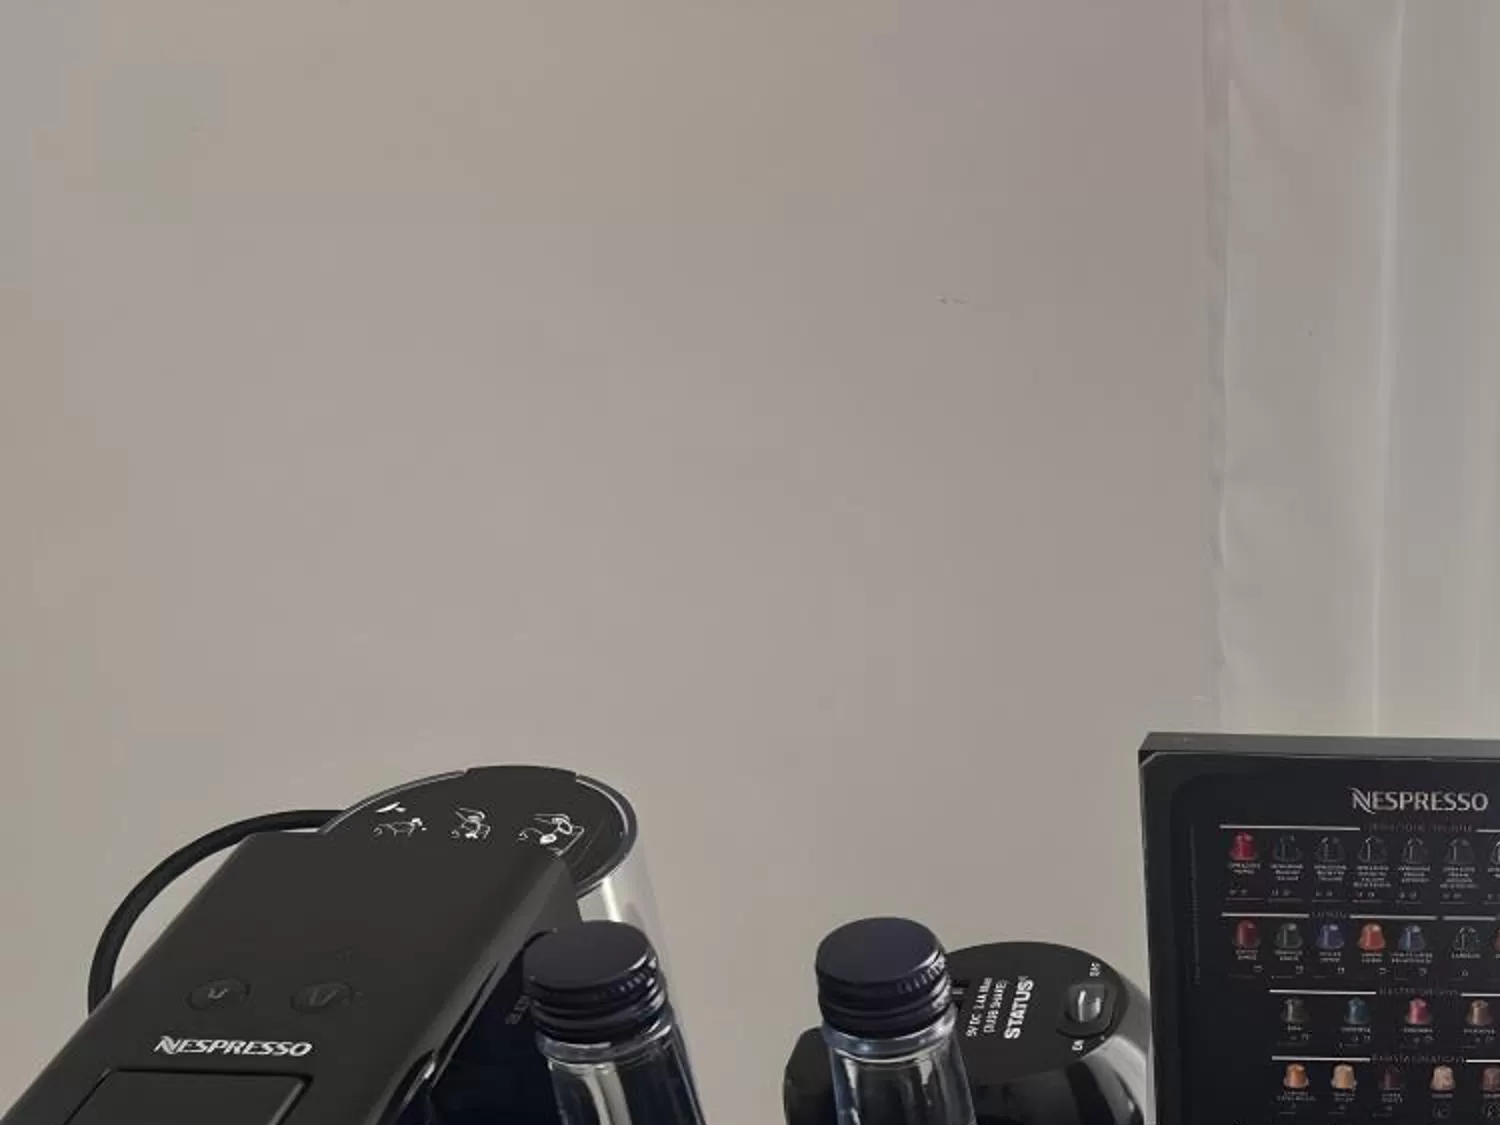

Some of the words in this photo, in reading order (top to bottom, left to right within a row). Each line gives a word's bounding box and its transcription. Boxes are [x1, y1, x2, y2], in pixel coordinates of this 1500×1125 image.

[1352, 787, 1489, 813] NESPRESSO
[1004, 979, 1034, 1039] STATUS
[154, 1035, 313, 1058] NESPRESSO
